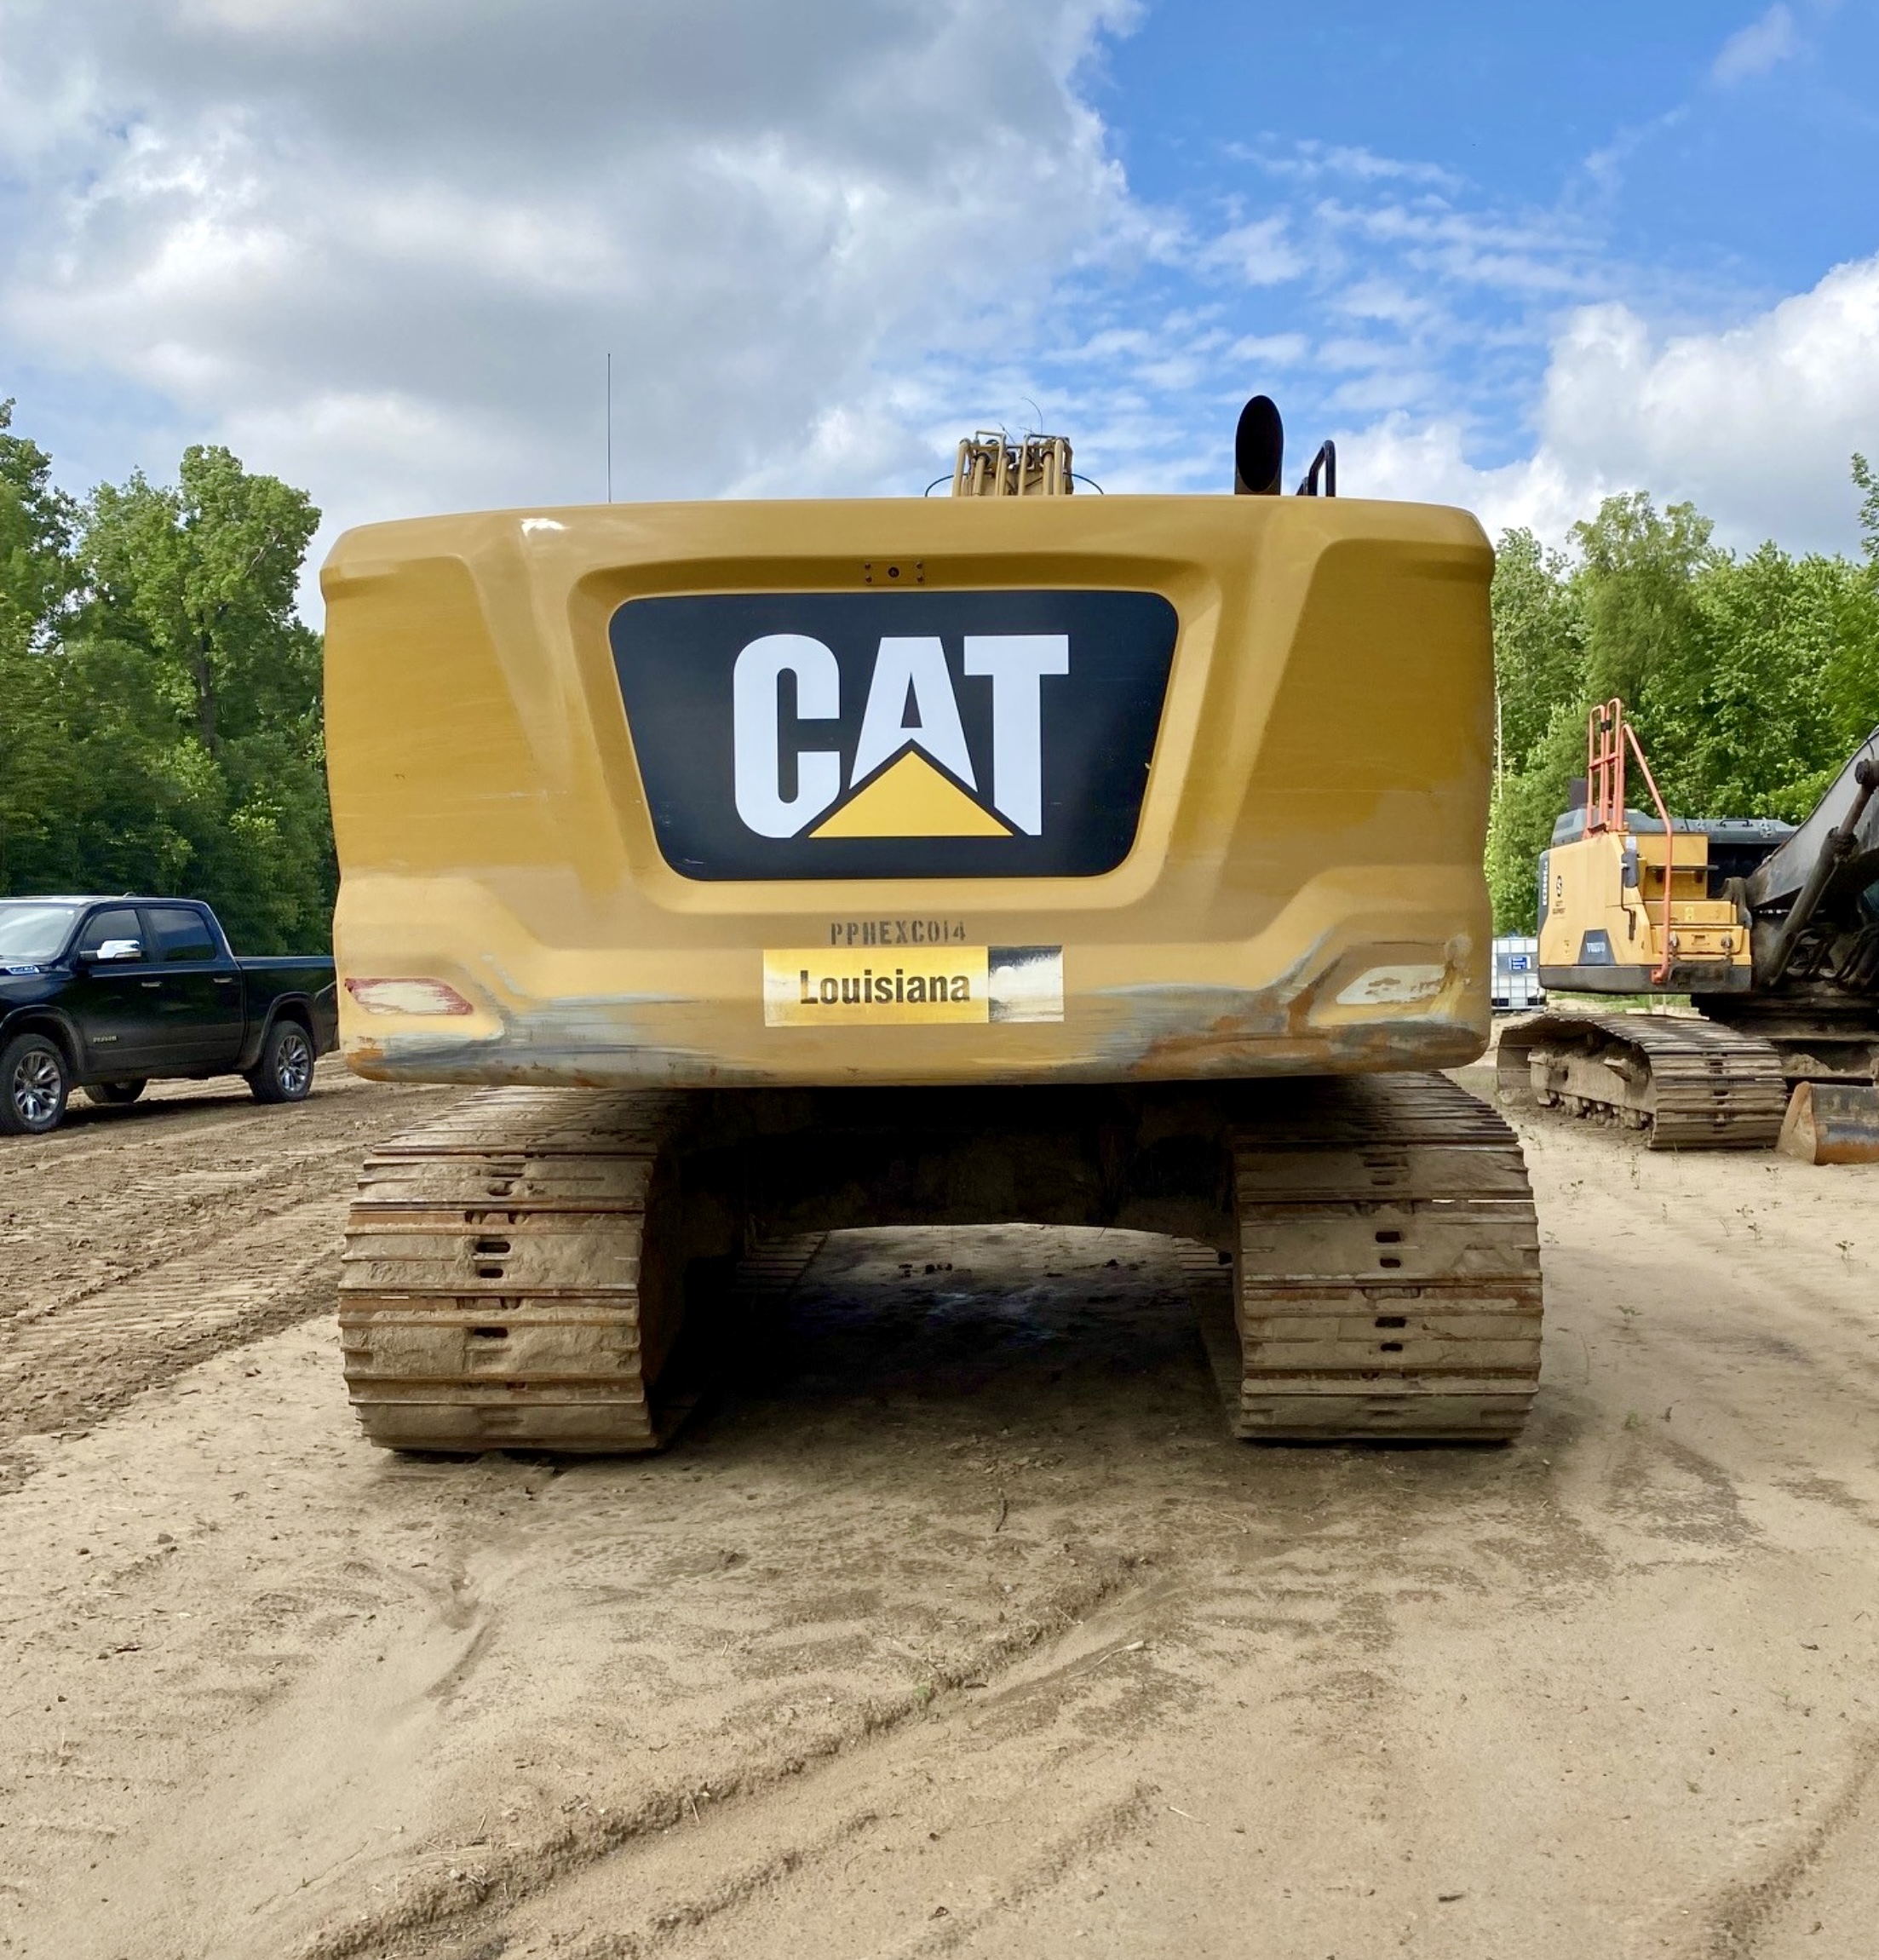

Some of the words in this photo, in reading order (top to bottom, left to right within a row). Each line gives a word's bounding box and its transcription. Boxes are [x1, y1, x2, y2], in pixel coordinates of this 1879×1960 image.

[733, 634, 1069, 838] CAT
[830, 920, 966, 946] PPHEXC014
[800, 969, 971, 1004] Louisiana
